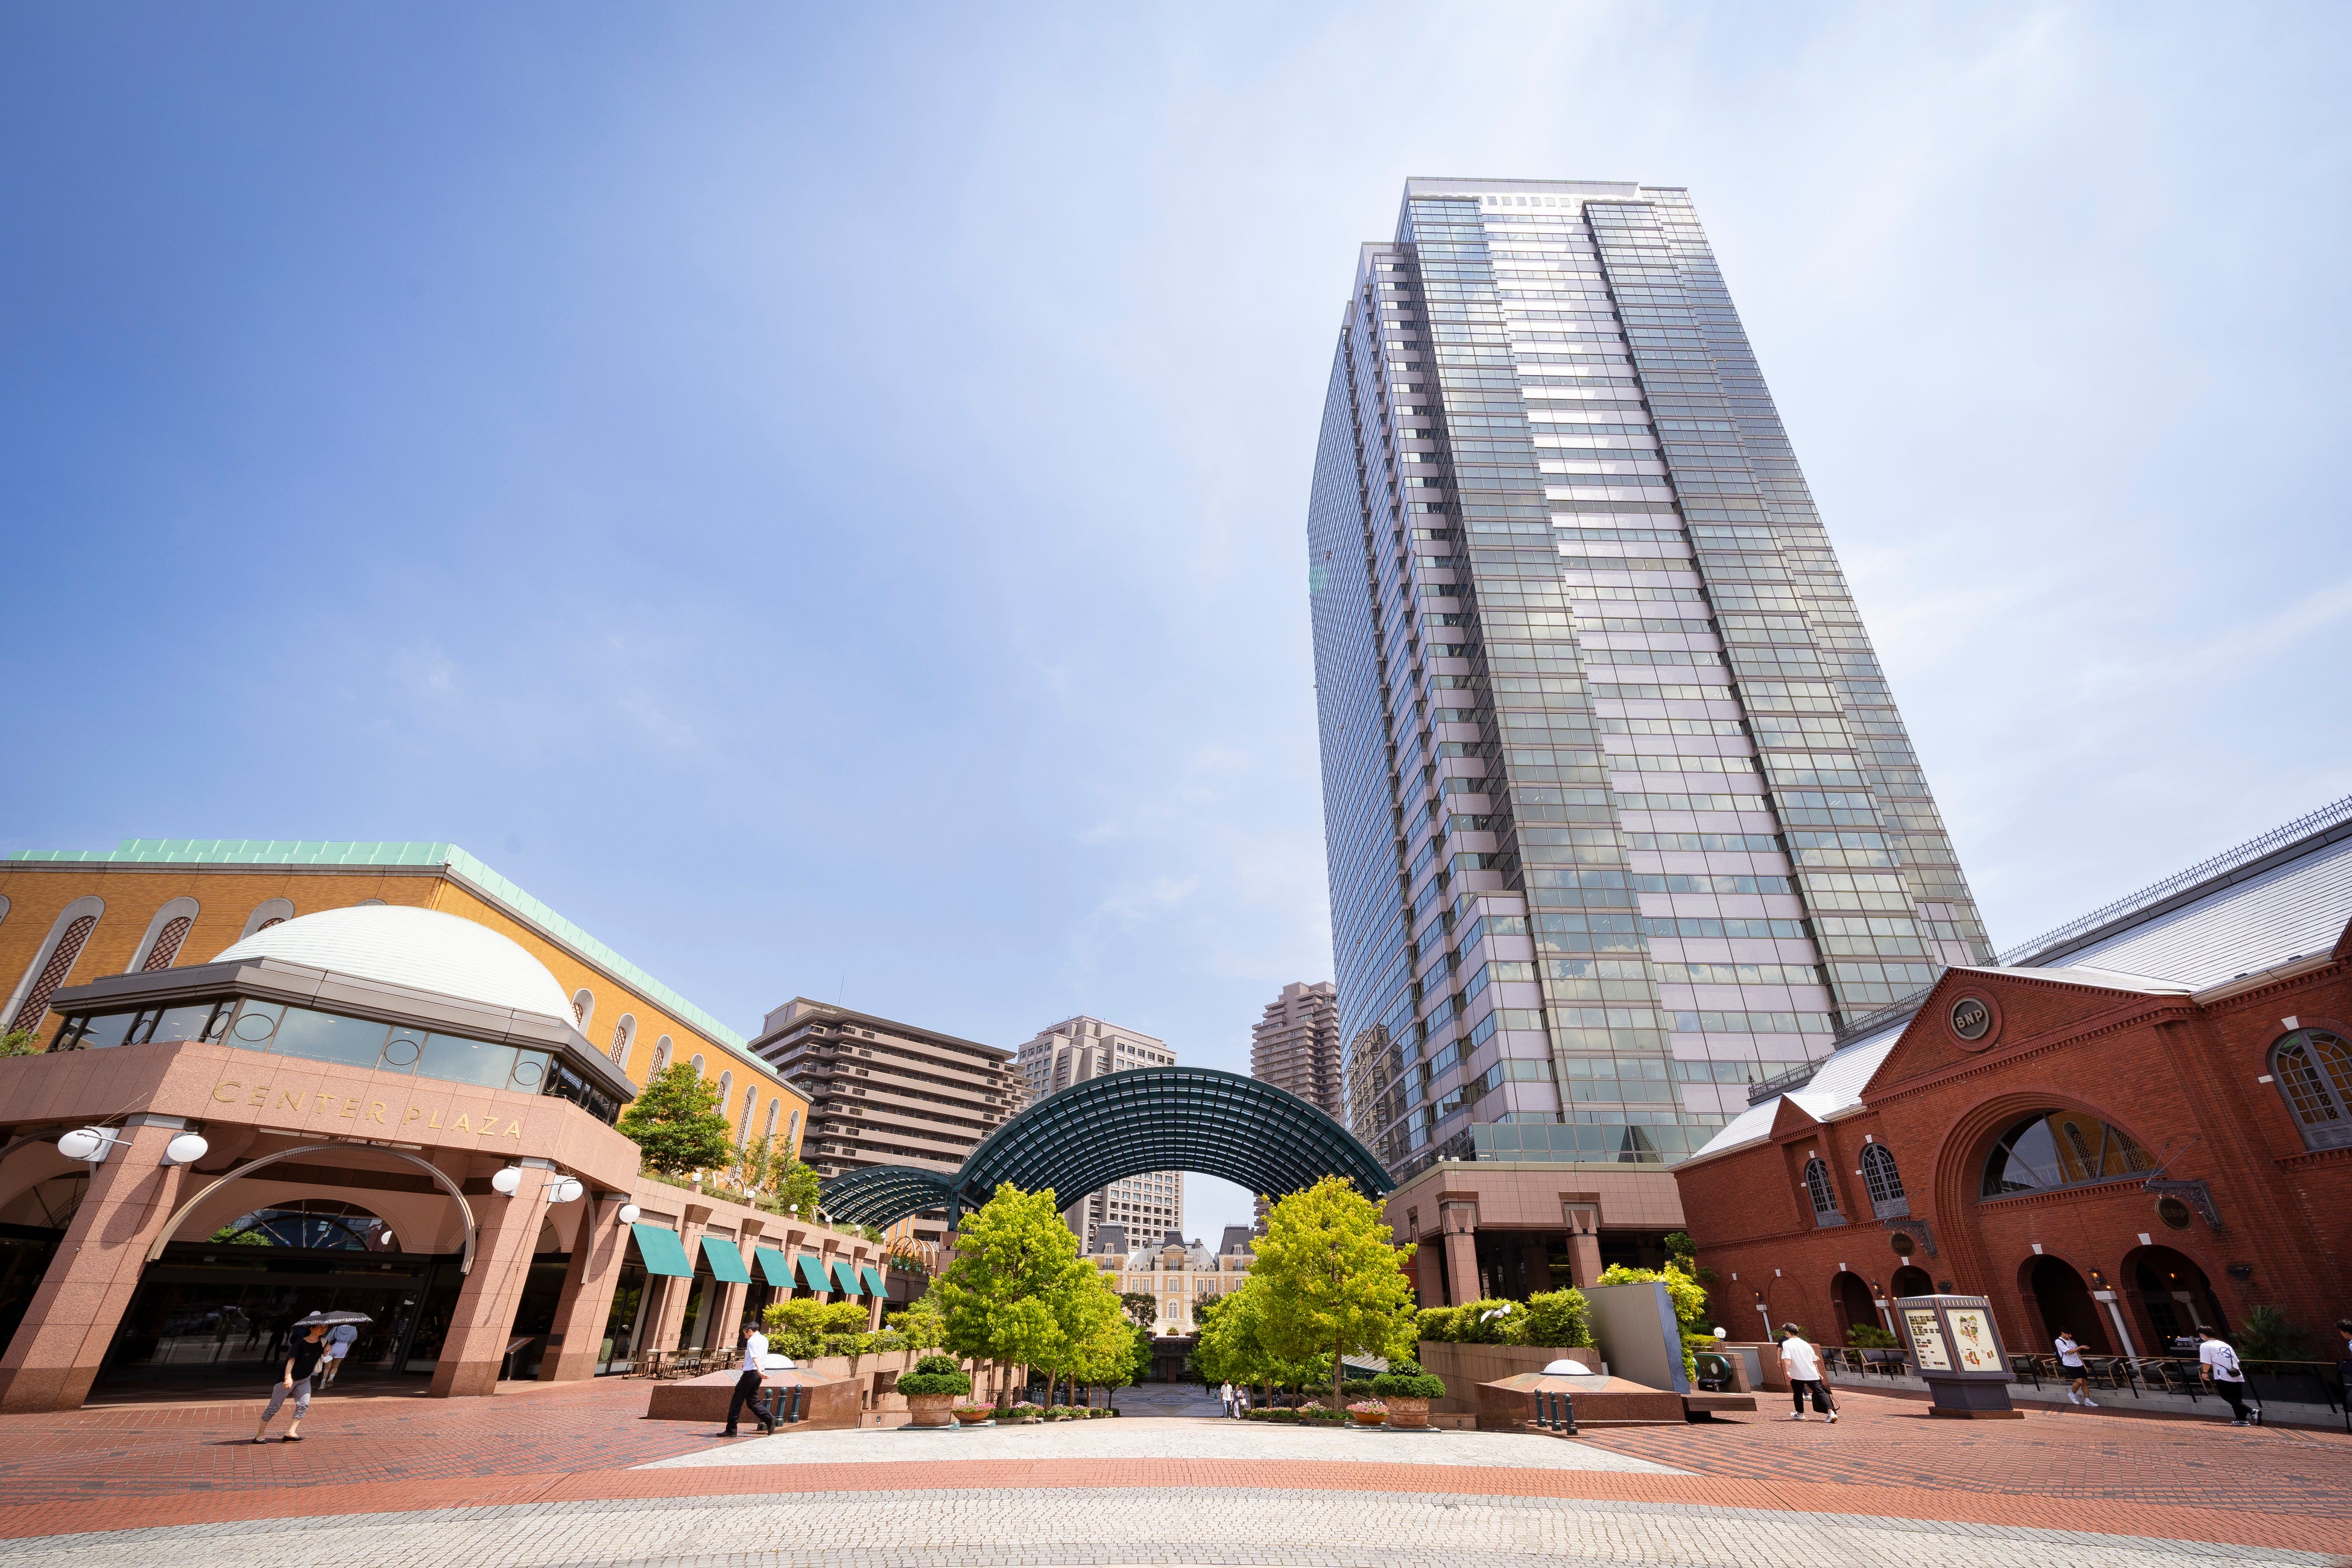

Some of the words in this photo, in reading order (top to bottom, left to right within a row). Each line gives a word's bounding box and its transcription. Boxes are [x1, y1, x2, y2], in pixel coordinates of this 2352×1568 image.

[1955, 1010, 1982, 1028] BNP
[213, 1081, 387, 1124] CENTER
[403, 1105, 520, 1139] PLAZA
[2161, 1208, 2187, 1218] BNP
